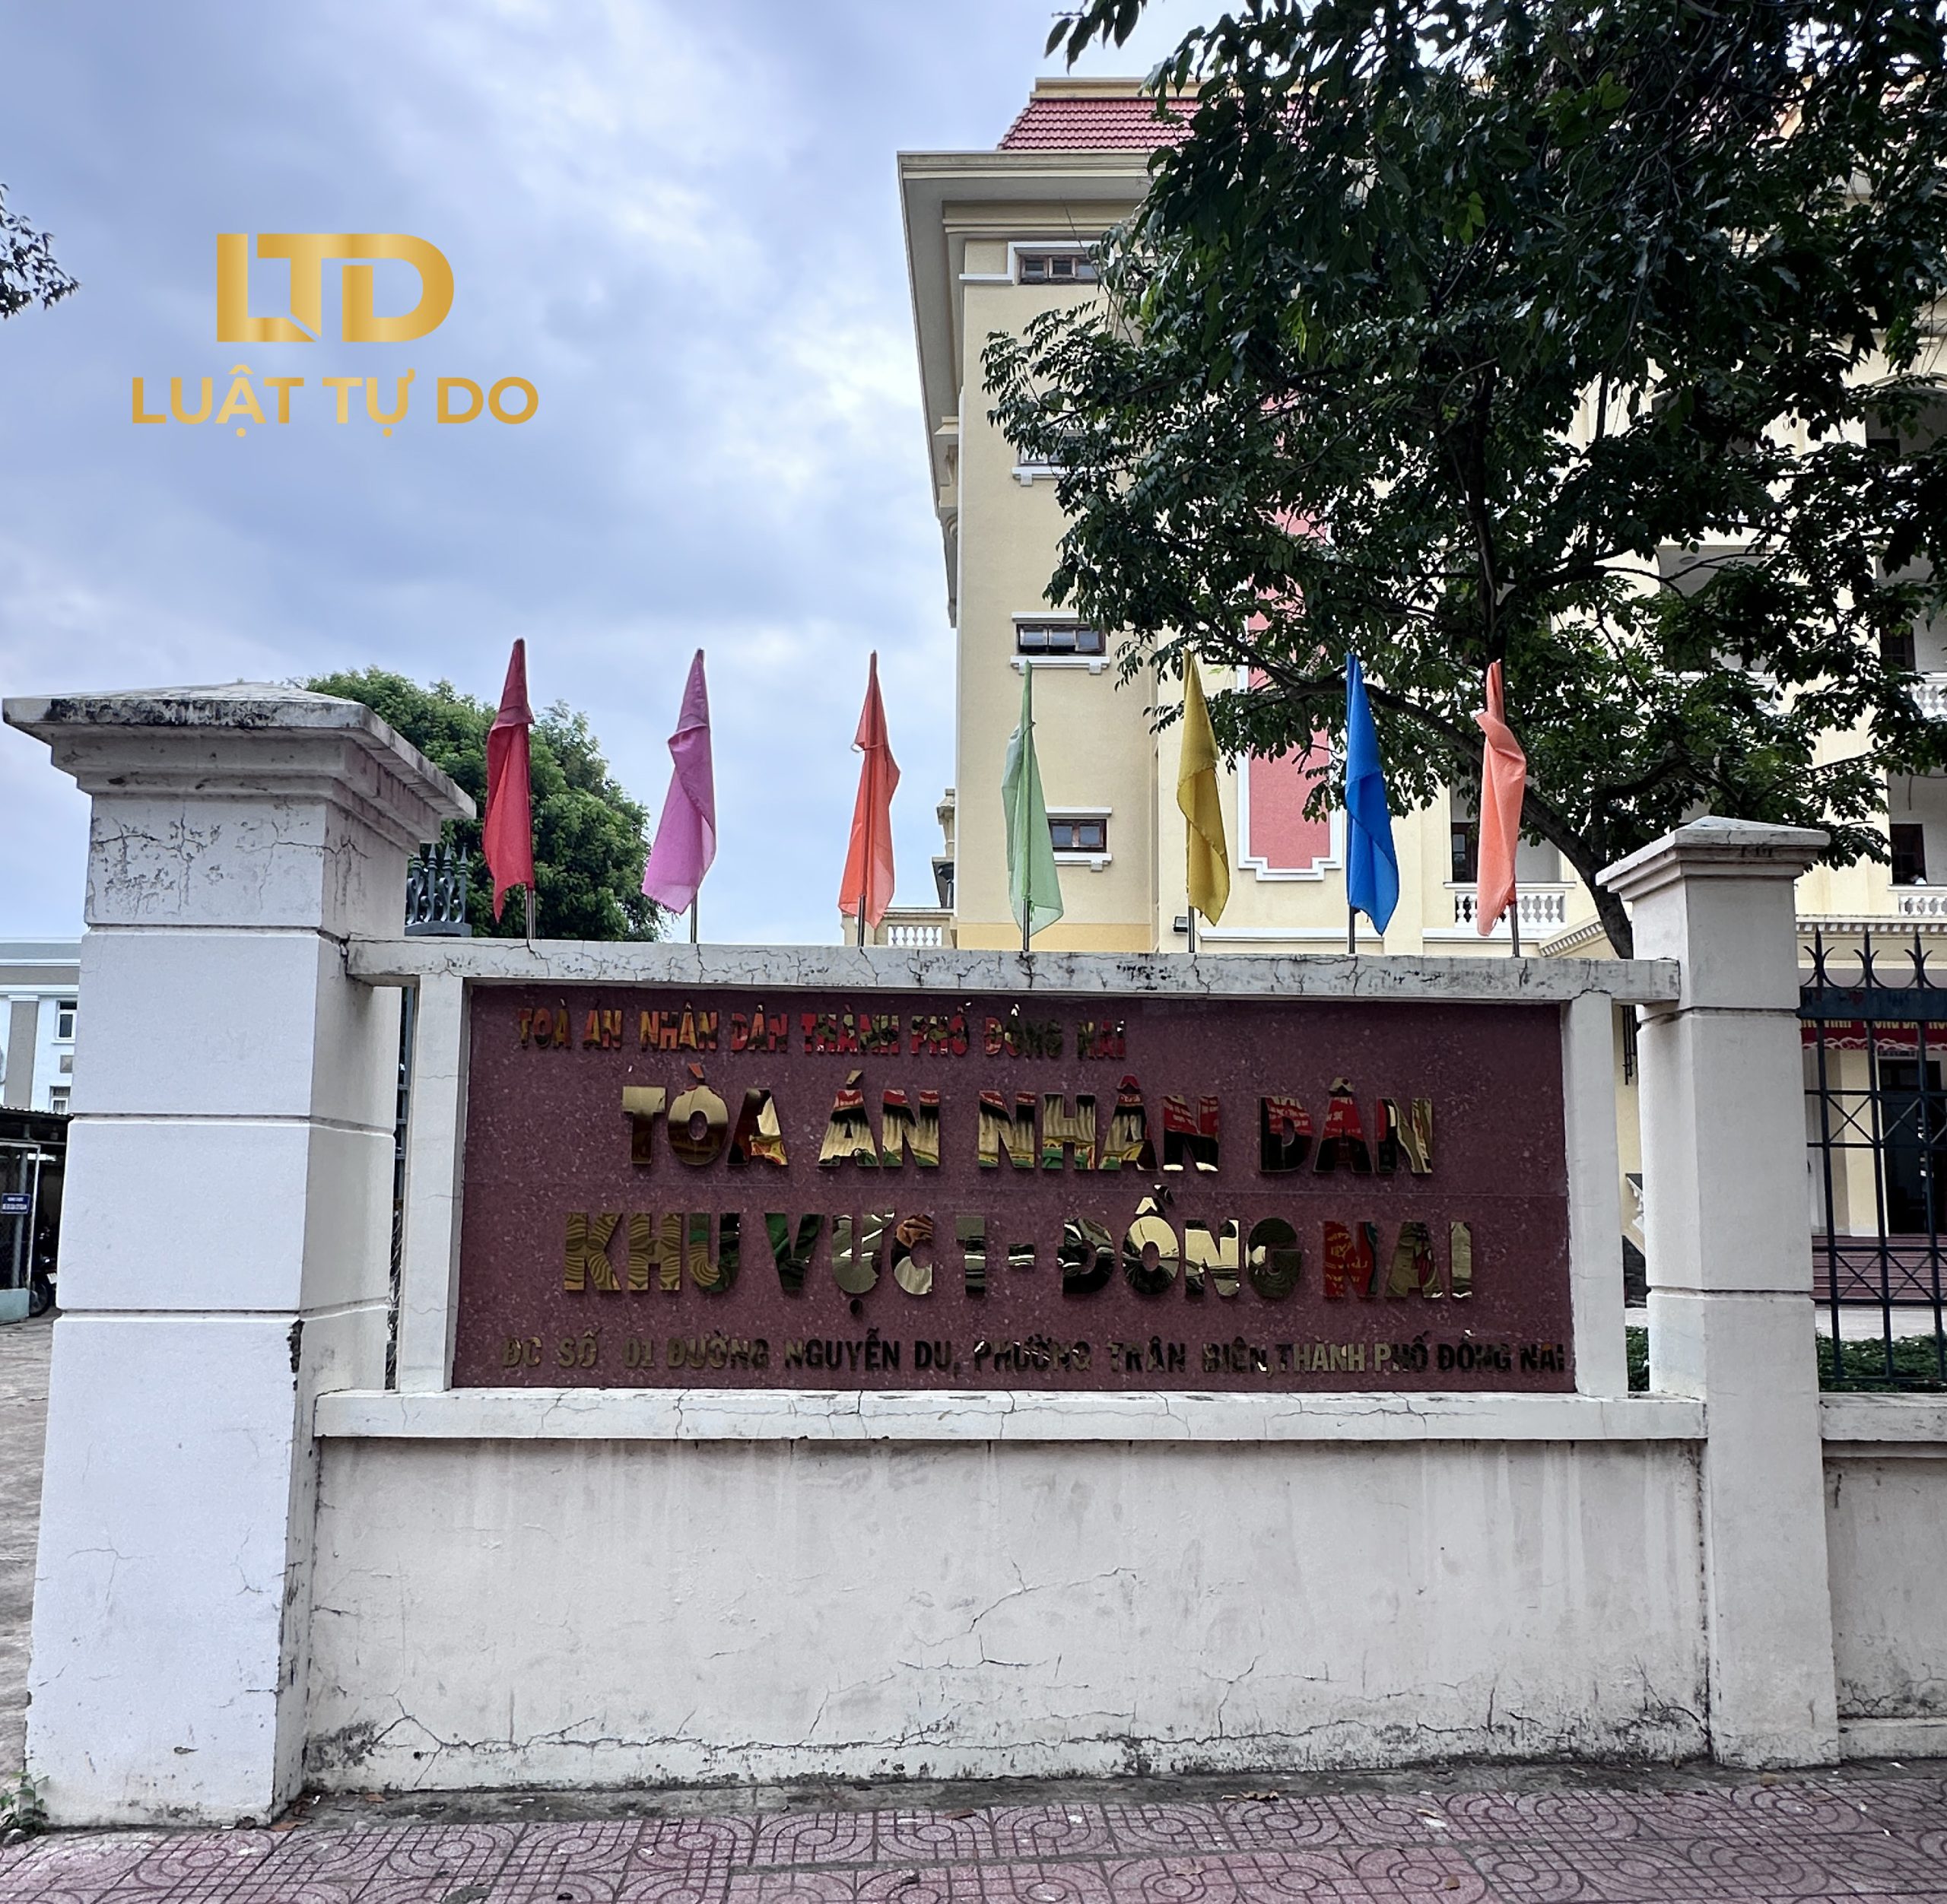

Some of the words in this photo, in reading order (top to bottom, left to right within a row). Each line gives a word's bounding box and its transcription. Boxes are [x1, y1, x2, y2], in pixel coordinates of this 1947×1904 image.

[640, 999, 718, 1052] NHÂN
[731, 1001, 788, 1053] DÂN
[801, 1004, 898, 1055] THÀNH
[1077, 1018, 1126, 1059] NAI
[622, 1063, 788, 1166] TÒA
[818, 1070, 939, 1167] ÁN
[979, 1074, 1218, 1172] NHÂN
[1260, 1077, 1433, 1174] DÂN
[564, 1213, 740, 1292] KHU
[764, 1207, 933, 1315] VỰC
[1057, 1184, 1301, 1298] ĐỒNG
[1324, 1220, 1472, 1299] NAI
[785, 1328, 900, 1371] NGUYỄN
[1372, 1330, 1428, 1372] PHỐ
[1520, 1344, 1564, 1372] NAI
